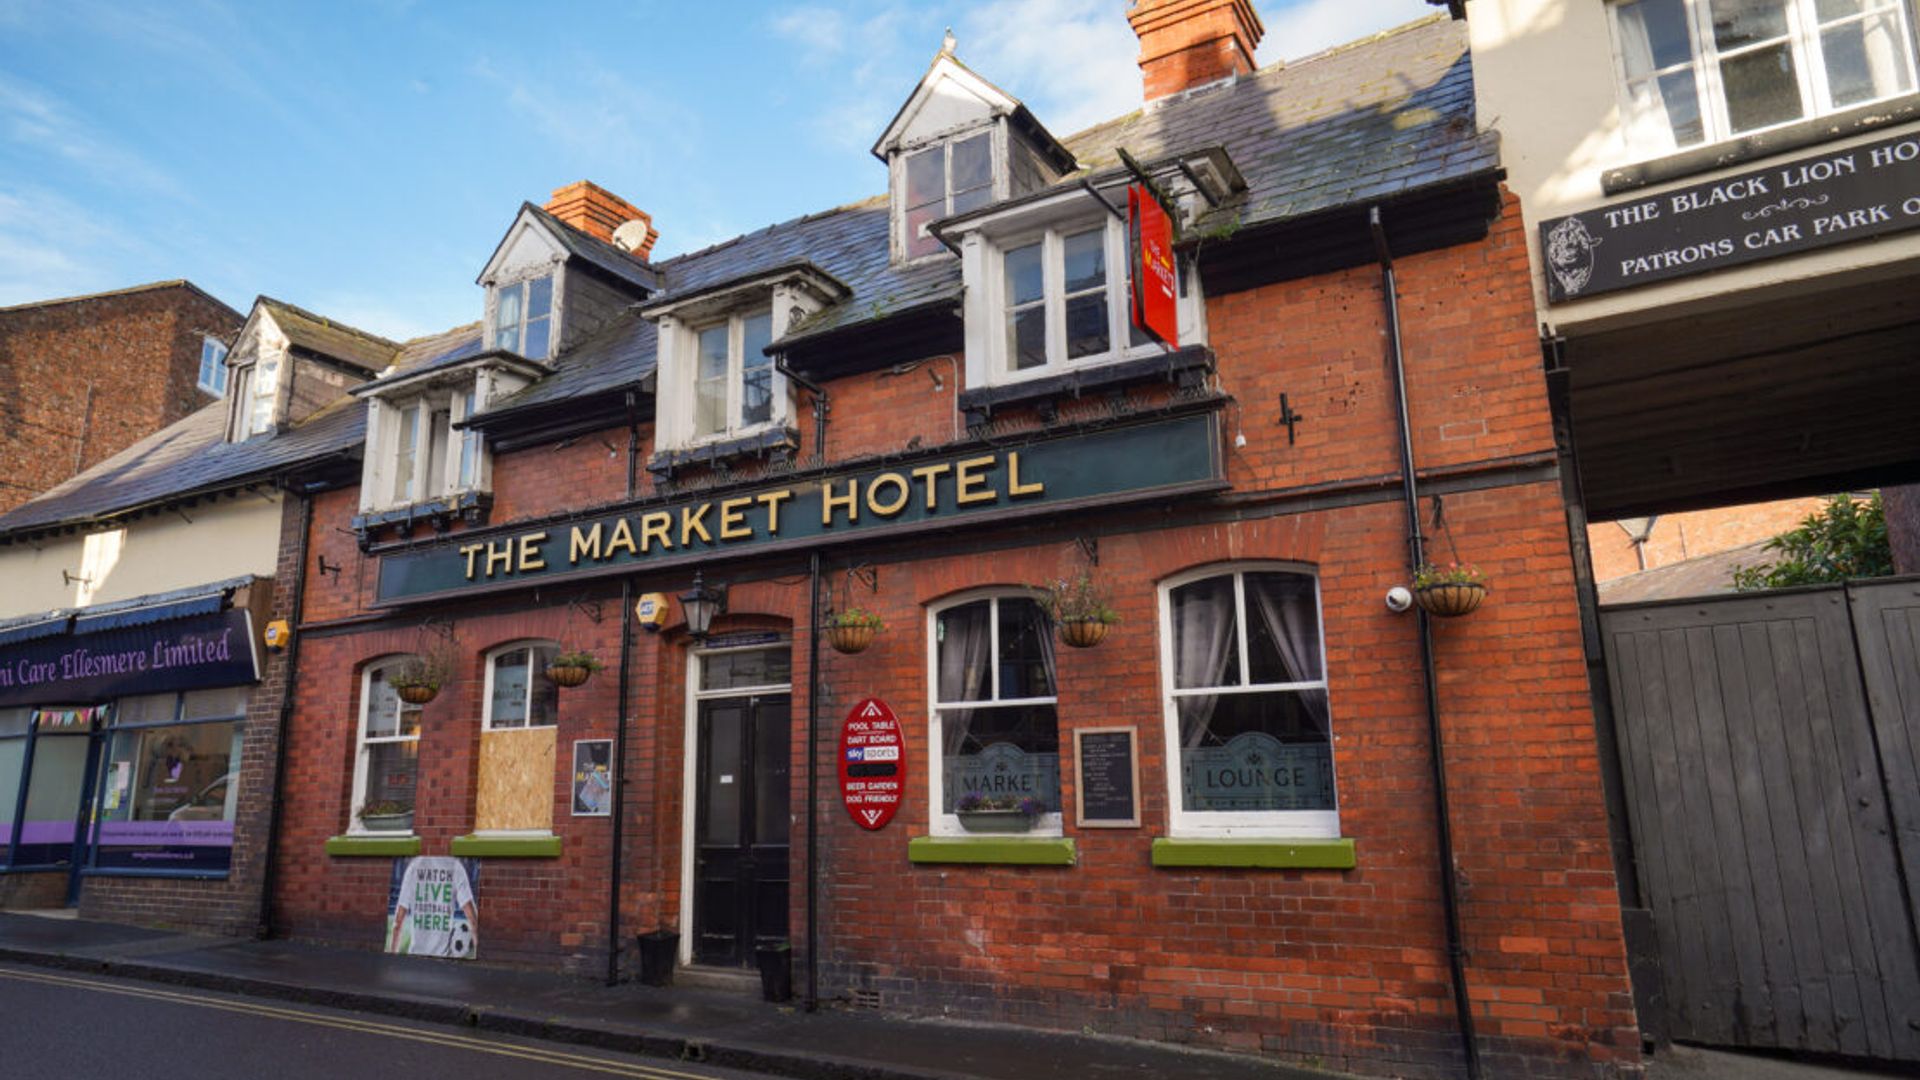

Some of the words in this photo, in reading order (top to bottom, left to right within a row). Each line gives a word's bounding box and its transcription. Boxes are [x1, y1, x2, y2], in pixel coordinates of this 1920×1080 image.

[1604, 202, 1660, 229] THE
[1671, 176, 1769, 214] BLACK
[1781, 155, 1856, 189] LION
[1621, 238, 1735, 277] PATRONS
[1744, 224, 1802, 250] CAR
[1813, 205, 1892, 236] PARK
[459, 531, 547, 580] THE
[568, 490, 790, 563] MARKET
[821, 451, 1044, 525] HOTEL
[18, 659, 57, 685] Care
[60, 648, 147, 680] Ellesmere
[152, 628, 232, 670] Limited
[848, 722, 869, 731] POOL
[872, 720, 895, 730] TABLE
[847, 735, 867, 745] DART
[869, 734, 897, 744] BOARD
[847, 747, 863, 760] sky
[866, 748, 897, 759] sports
[846, 782, 866, 791] BEER
[867, 782, 898, 790] GARDEN
[963, 773, 1044, 792] MARKET
[1207, 766, 1306, 789] LOUNGE
[846, 795, 862, 804] DOG
[865, 794, 898, 803] FRIENDLY
[417, 868, 453, 881] WATCH
[415, 882, 453, 903] LIVE
[413, 914, 451, 932] HERE
